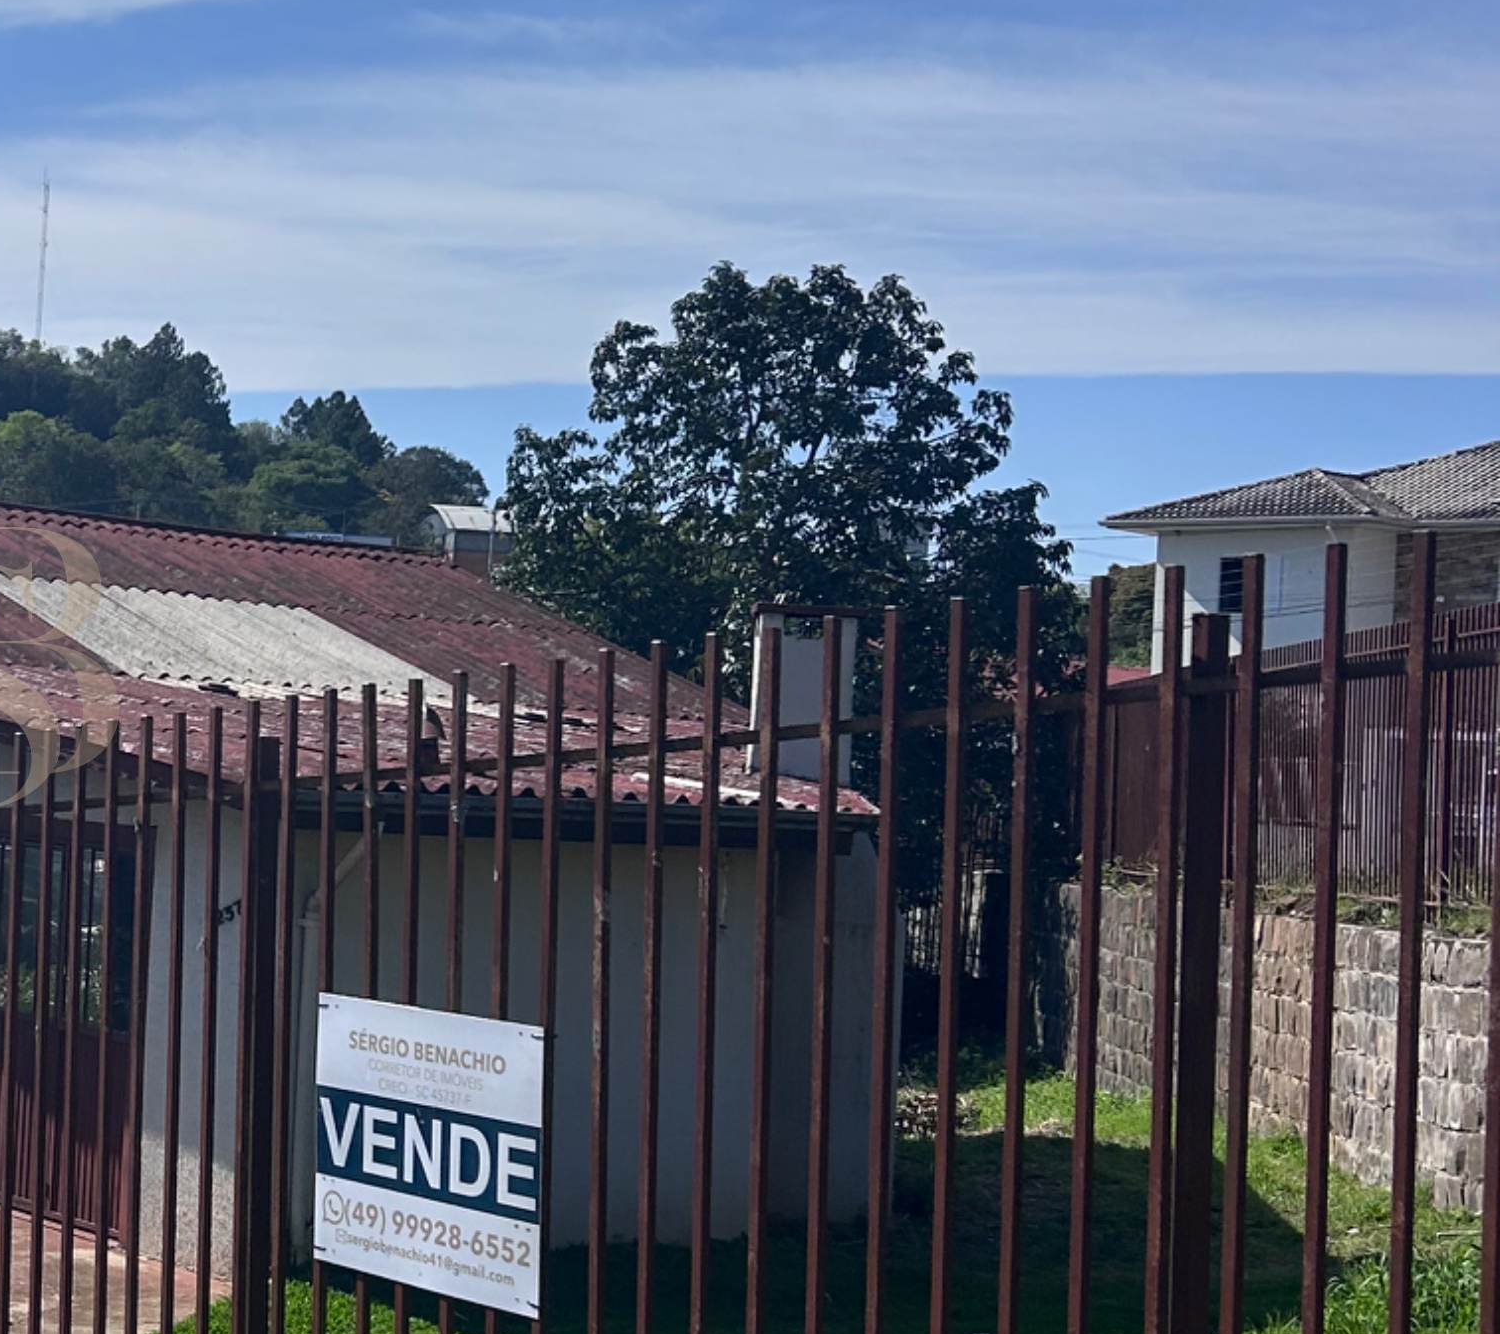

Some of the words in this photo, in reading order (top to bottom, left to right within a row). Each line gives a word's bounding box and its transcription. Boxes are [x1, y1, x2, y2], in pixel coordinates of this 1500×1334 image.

[349, 1028, 409, 1058] SÉRGIO
[414, 1042, 506, 1075] BENACHIO
[368, 1058, 421, 1079] CORRETOR
[424, 1068, 438, 1083] DE
[440, 1071, 484, 1092] IMÓVEIS
[319, 1097, 537, 1212] VENDE
[344, 1199, 386, 1235] (49)
[392, 1210, 531, 1268] 99928-6552
[346, 1233, 515, 1286] sergiobenachio41@gmail.com
